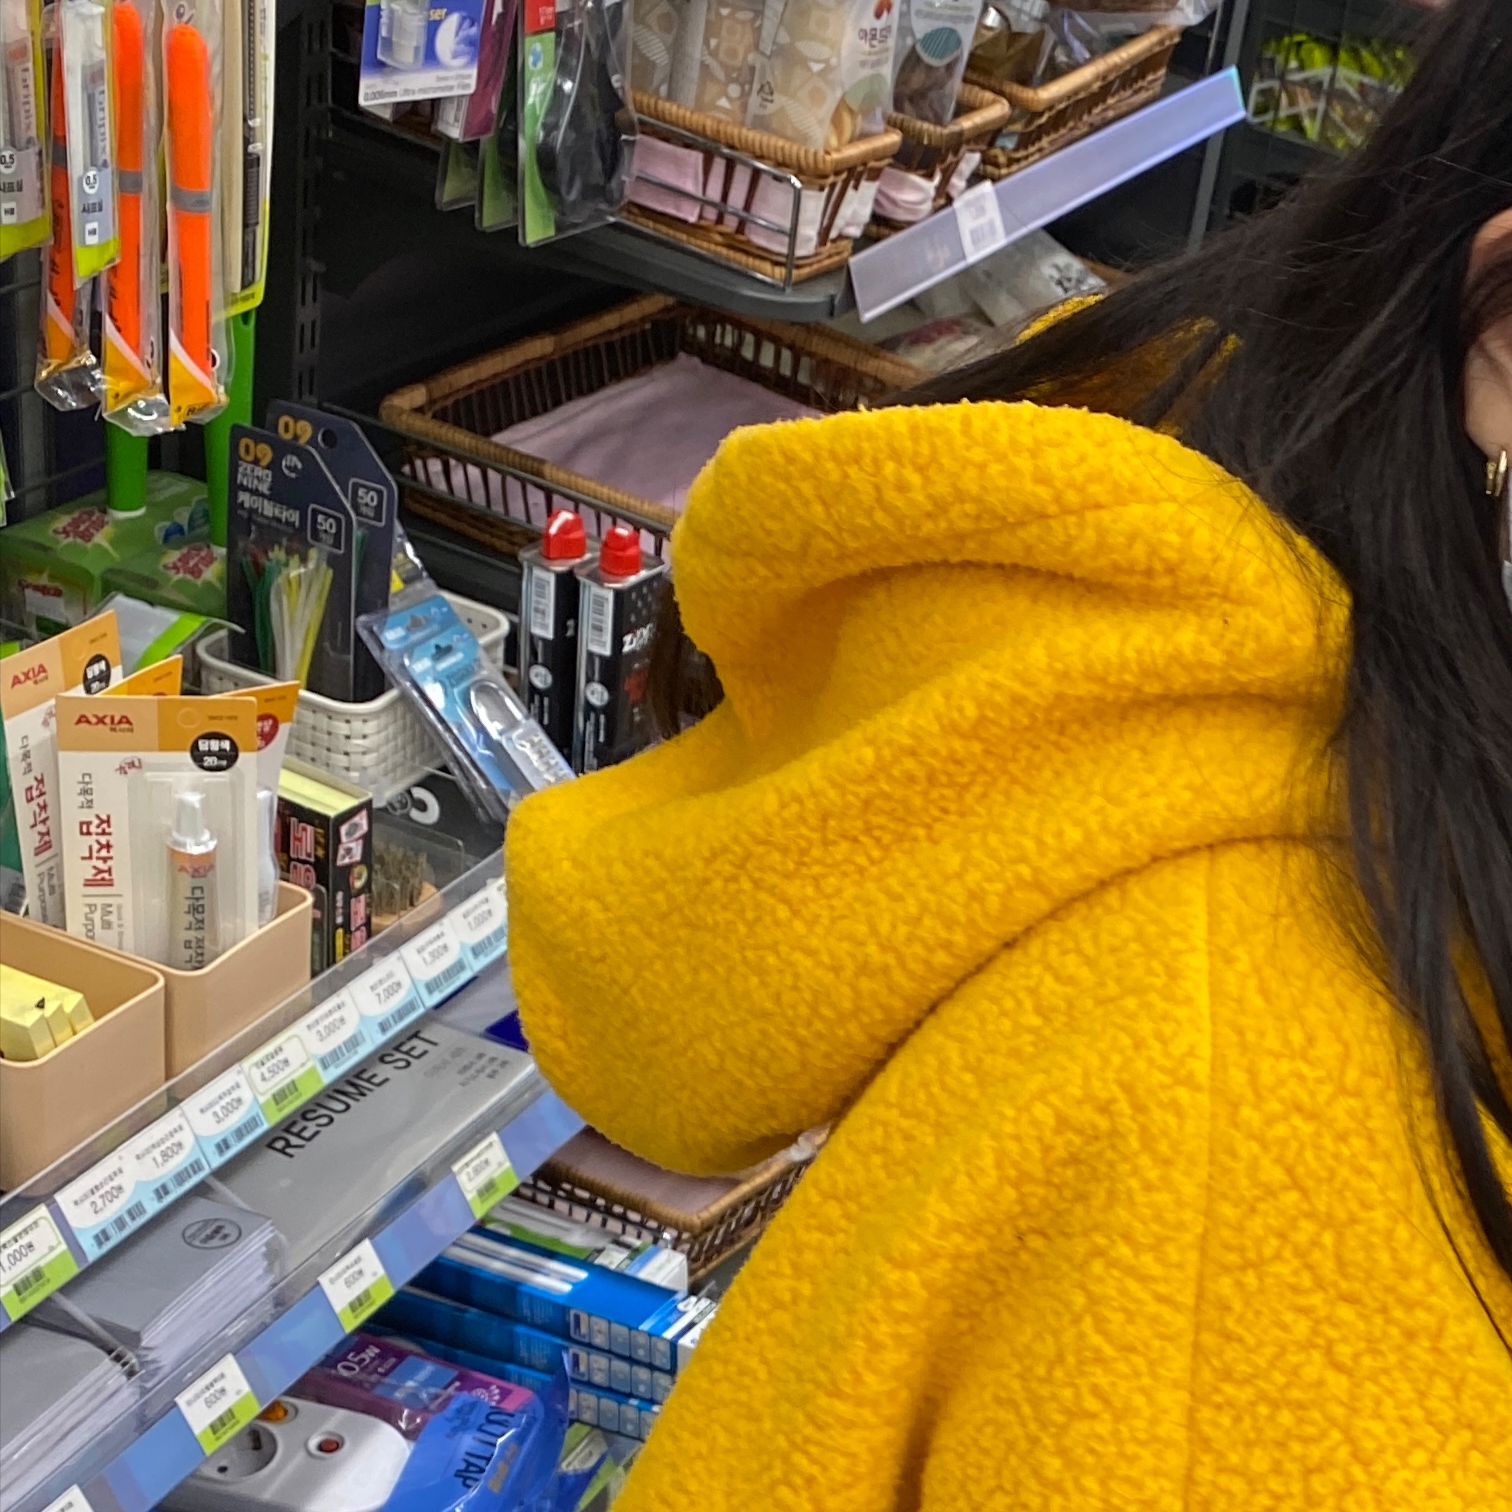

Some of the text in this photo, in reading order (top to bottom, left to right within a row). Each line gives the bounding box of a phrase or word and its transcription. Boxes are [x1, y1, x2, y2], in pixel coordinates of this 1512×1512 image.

[278, 415, 313, 446] 09
[238, 438, 273, 467] 09
[357, 487, 378, 507] 50
[316, 513, 337, 534] 50
[10, 664, 48, 689] AXIA
[74, 714, 134, 726] AXIA
[24, 773, 53, 857] 접착제
[77, 772, 114, 888] 다목적 접착제
[101, 903, 113, 931] Multi
[266, 1067, 390, 1159] RESUME
[378, 1029, 439, 1085] SET
[90, 1185, 124, 1215] 2,700원
